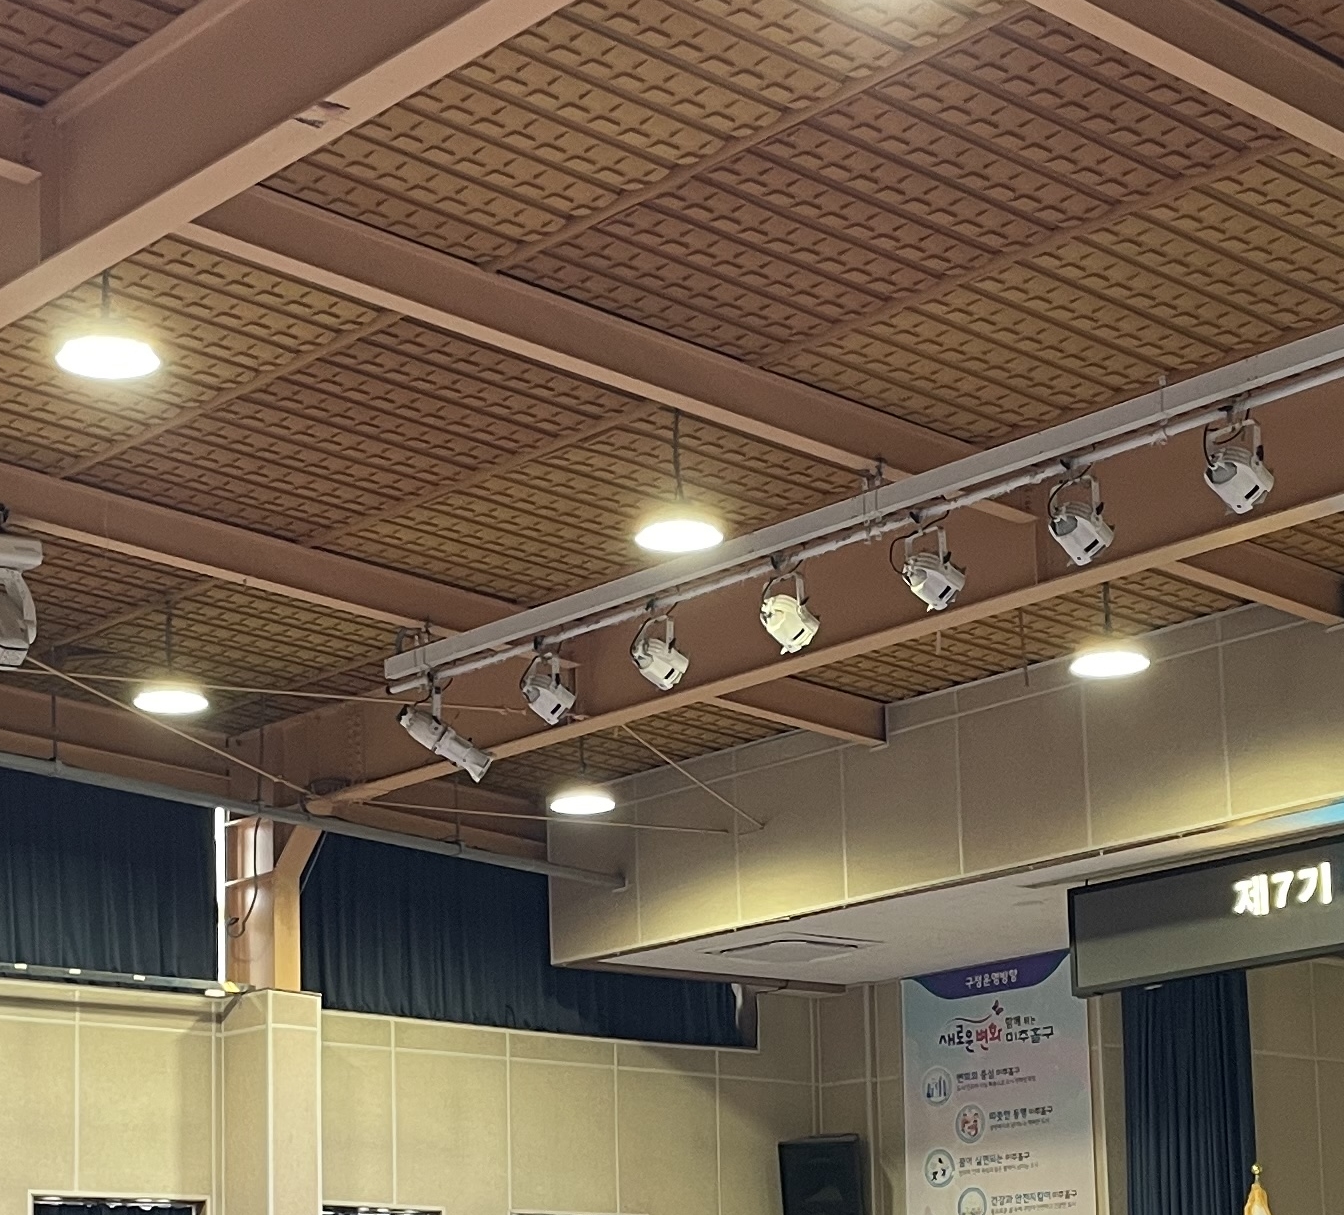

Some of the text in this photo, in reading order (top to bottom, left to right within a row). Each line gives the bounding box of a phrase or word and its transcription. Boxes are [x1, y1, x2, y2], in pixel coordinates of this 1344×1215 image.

[1231, 861, 1333, 917] 제7기
[939, 1022, 1003, 1053] 새로운 변화
[1005, 1026, 1054, 1044] 미추홀구
